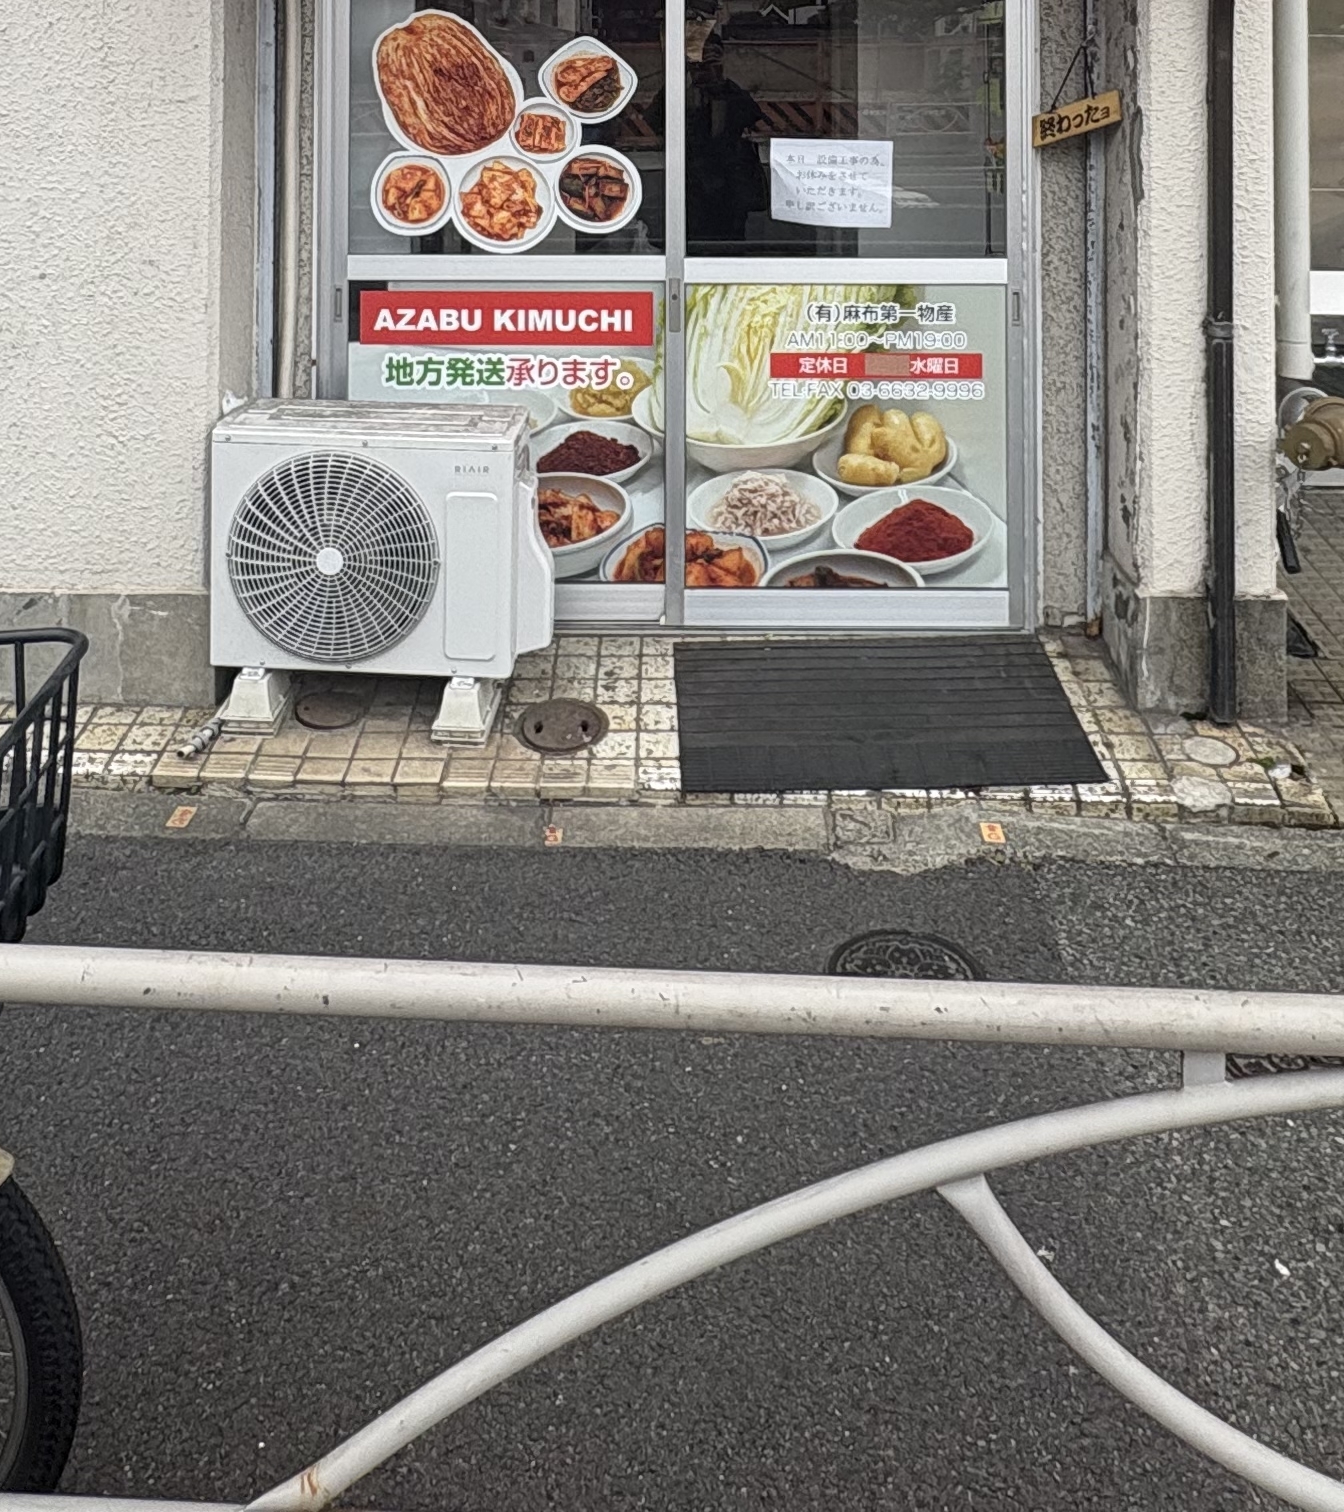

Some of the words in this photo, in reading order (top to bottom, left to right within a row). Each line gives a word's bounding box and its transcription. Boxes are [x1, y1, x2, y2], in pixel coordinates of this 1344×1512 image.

[373, 308, 483, 332] AZABU
[493, 307, 634, 333] KIMUCHI
[384, 356, 632, 388] 地方発送承ります。
[799, 357, 848, 374] 定休日
[910, 357, 959, 374] 水曜日
